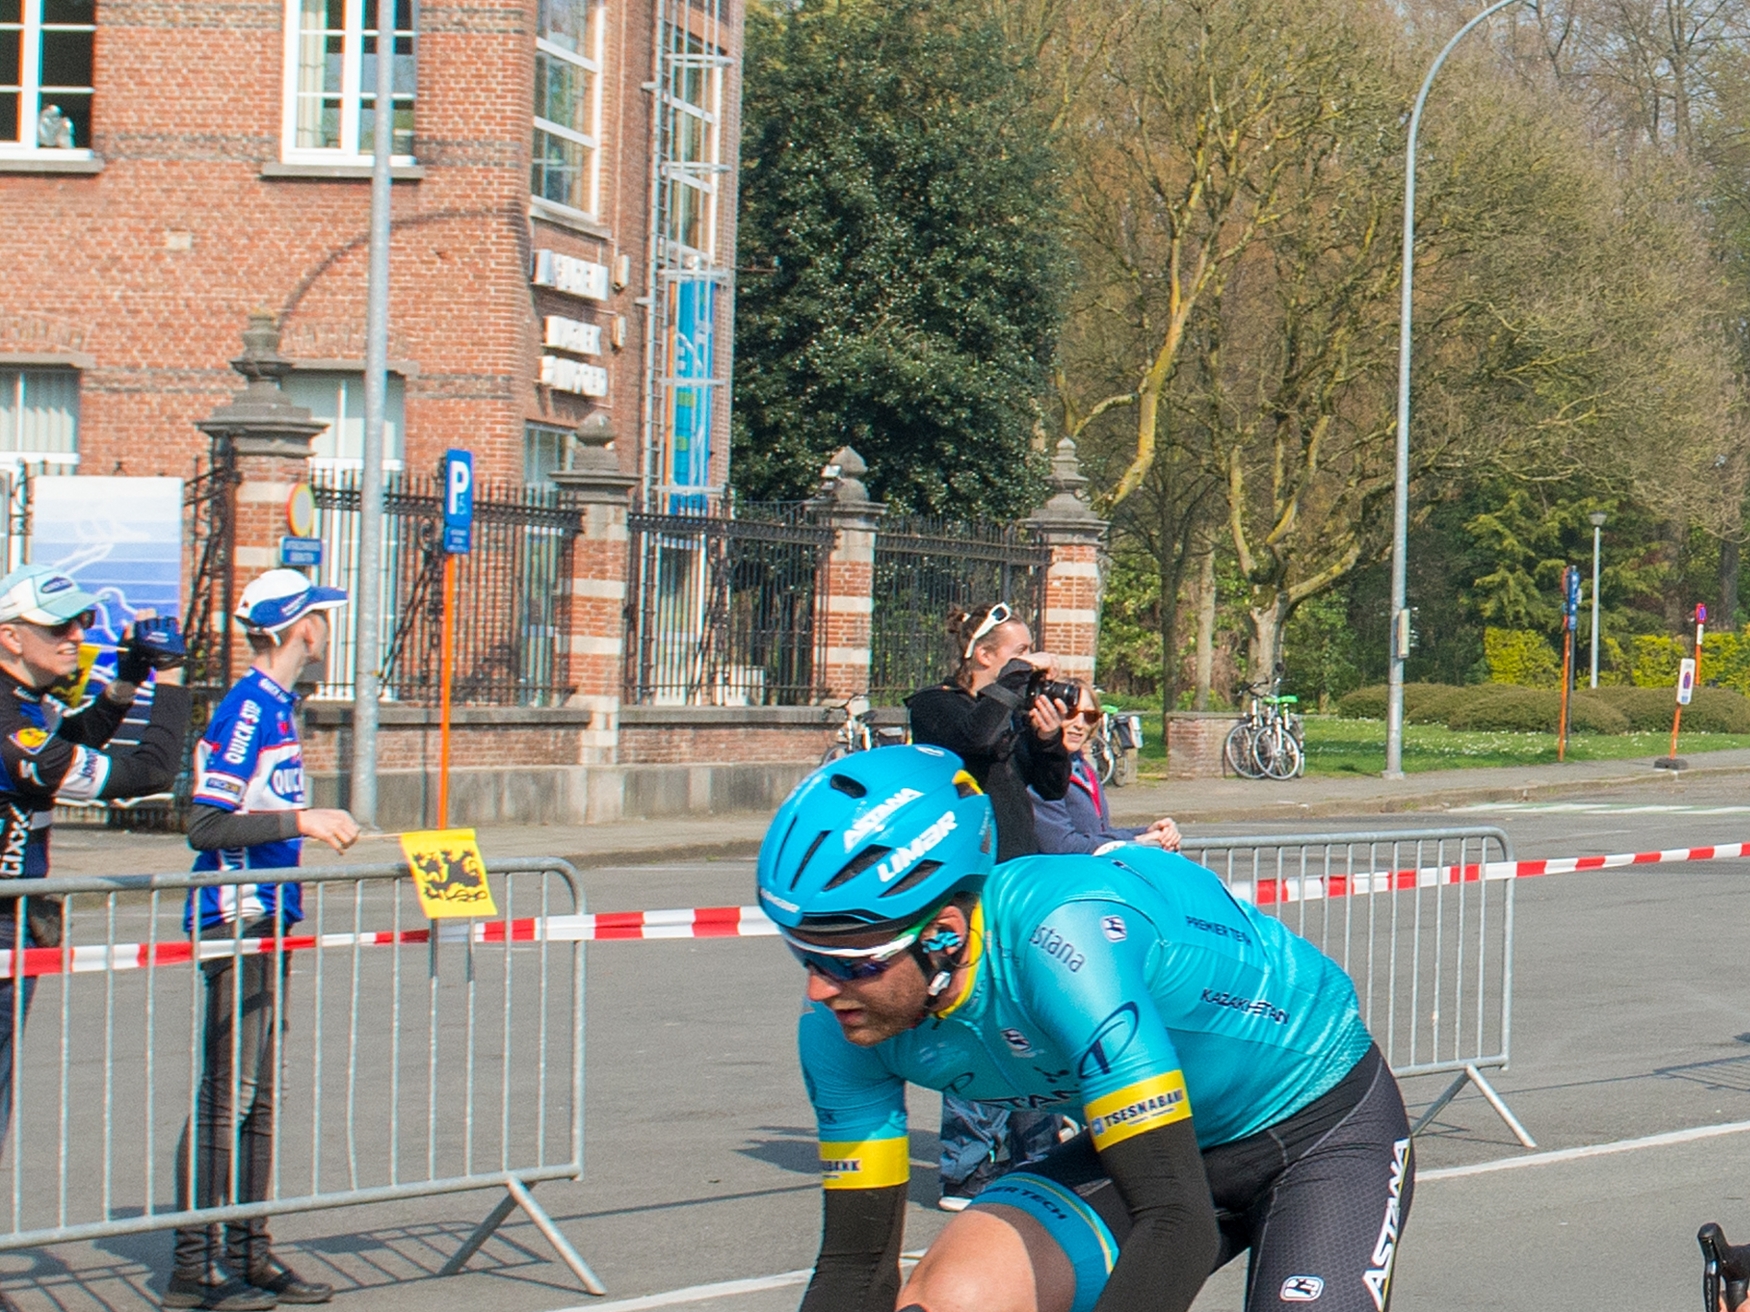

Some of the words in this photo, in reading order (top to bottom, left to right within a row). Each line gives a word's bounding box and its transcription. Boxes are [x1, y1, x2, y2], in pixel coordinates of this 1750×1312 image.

[449, 461, 470, 515] P
[843, 787, 925, 853] ASTANA
[1021, 1188, 1070, 1222] TECH
